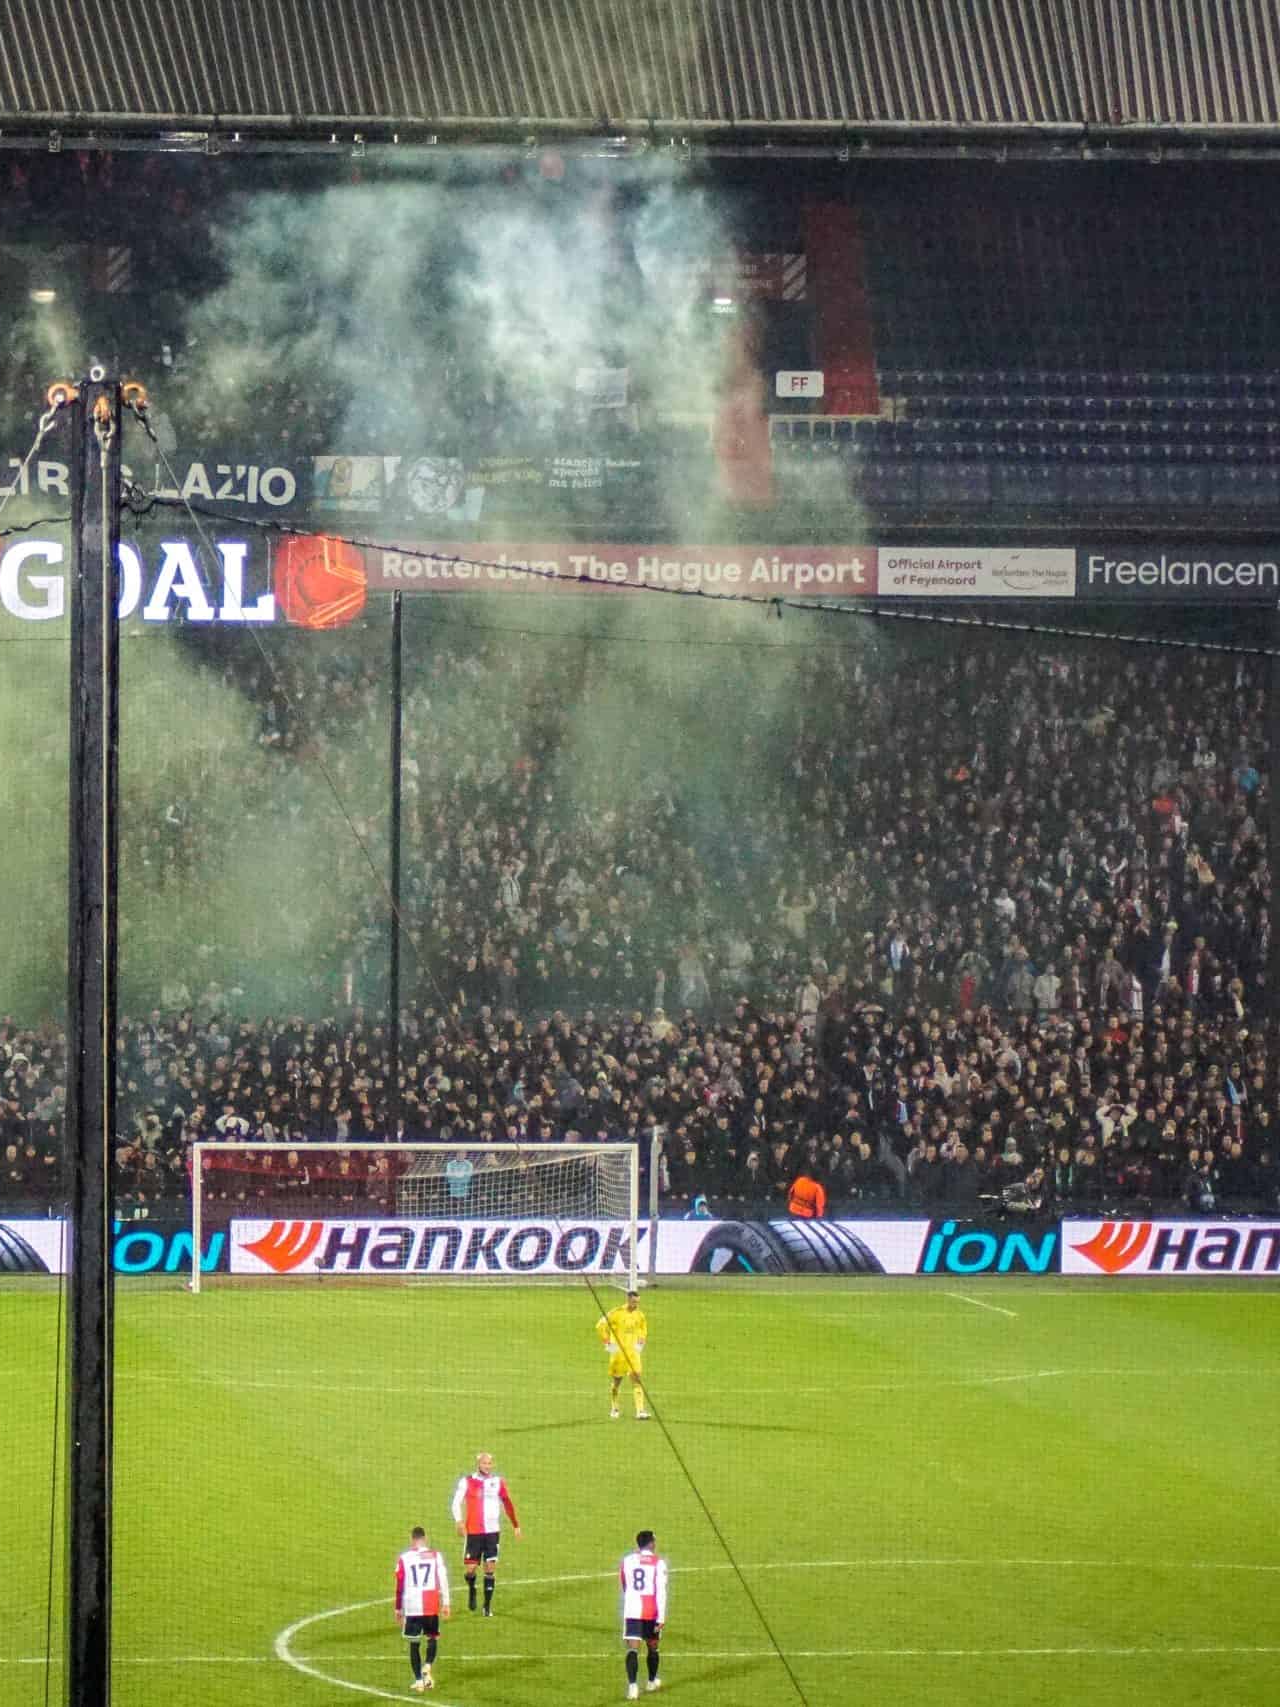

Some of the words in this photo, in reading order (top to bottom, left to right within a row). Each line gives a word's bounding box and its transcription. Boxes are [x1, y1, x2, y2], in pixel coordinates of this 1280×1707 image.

[791, 377, 809, 391] FF
[382, 550, 560, 579] Rotterdam
[569, 554, 629, 582] The
[637, 557, 743, 589] Hague
[751, 557, 865, 591] Airport
[887, 558, 936, 571] Official
[937, 559, 983, 573] Airport
[893, 574, 907, 586] of
[410, 1563, 432, 1587] 17
[633, 1567, 646, 1591] 8
